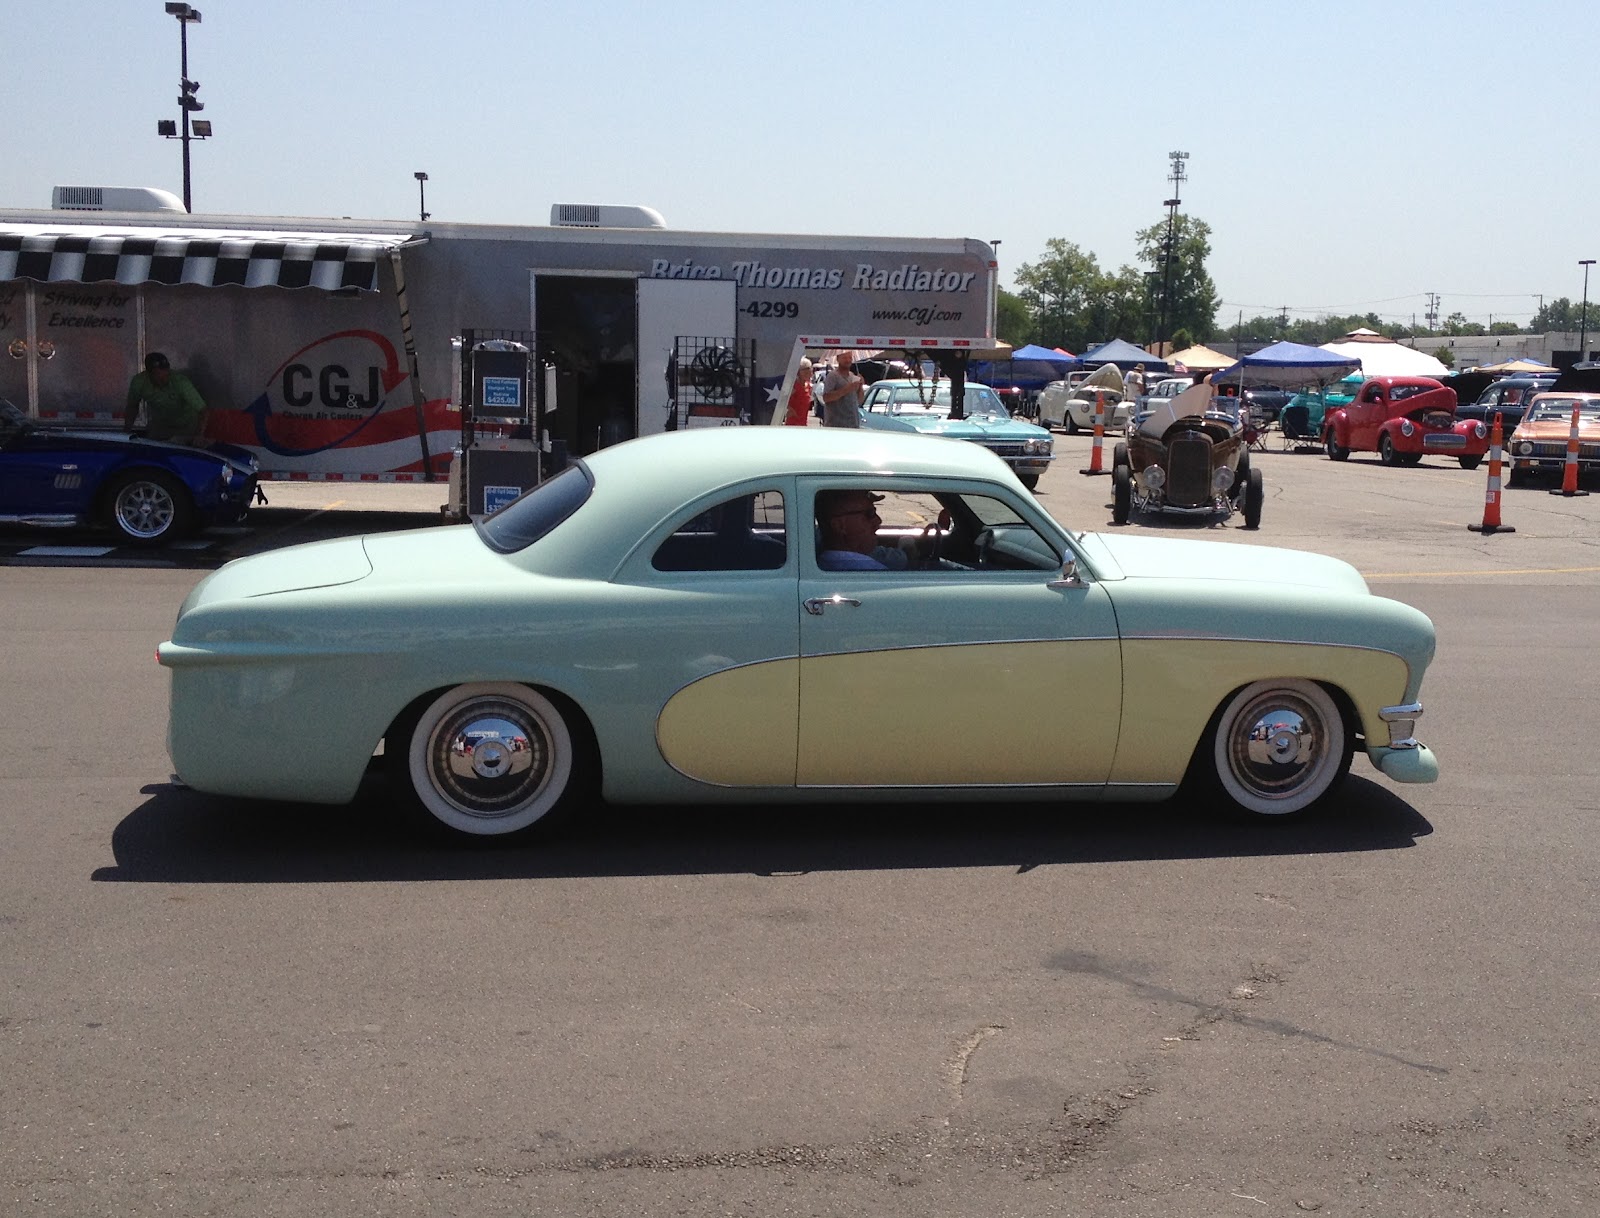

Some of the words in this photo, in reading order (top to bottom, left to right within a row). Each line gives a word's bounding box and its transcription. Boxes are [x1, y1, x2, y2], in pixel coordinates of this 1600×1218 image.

[732, 261, 844, 289] Thomas
[851, 263, 976, 293] Radiator
[43, 290, 103, 310] Striving
[105, 290, 131, 308] for
[739, 301, 799, 319] -4299
[871, 304, 963, 326] www.cgj.com
[48, 312, 126, 329] Excellence
[316, 411, 328, 420] Air
[330, 411, 363, 421] Coolers
